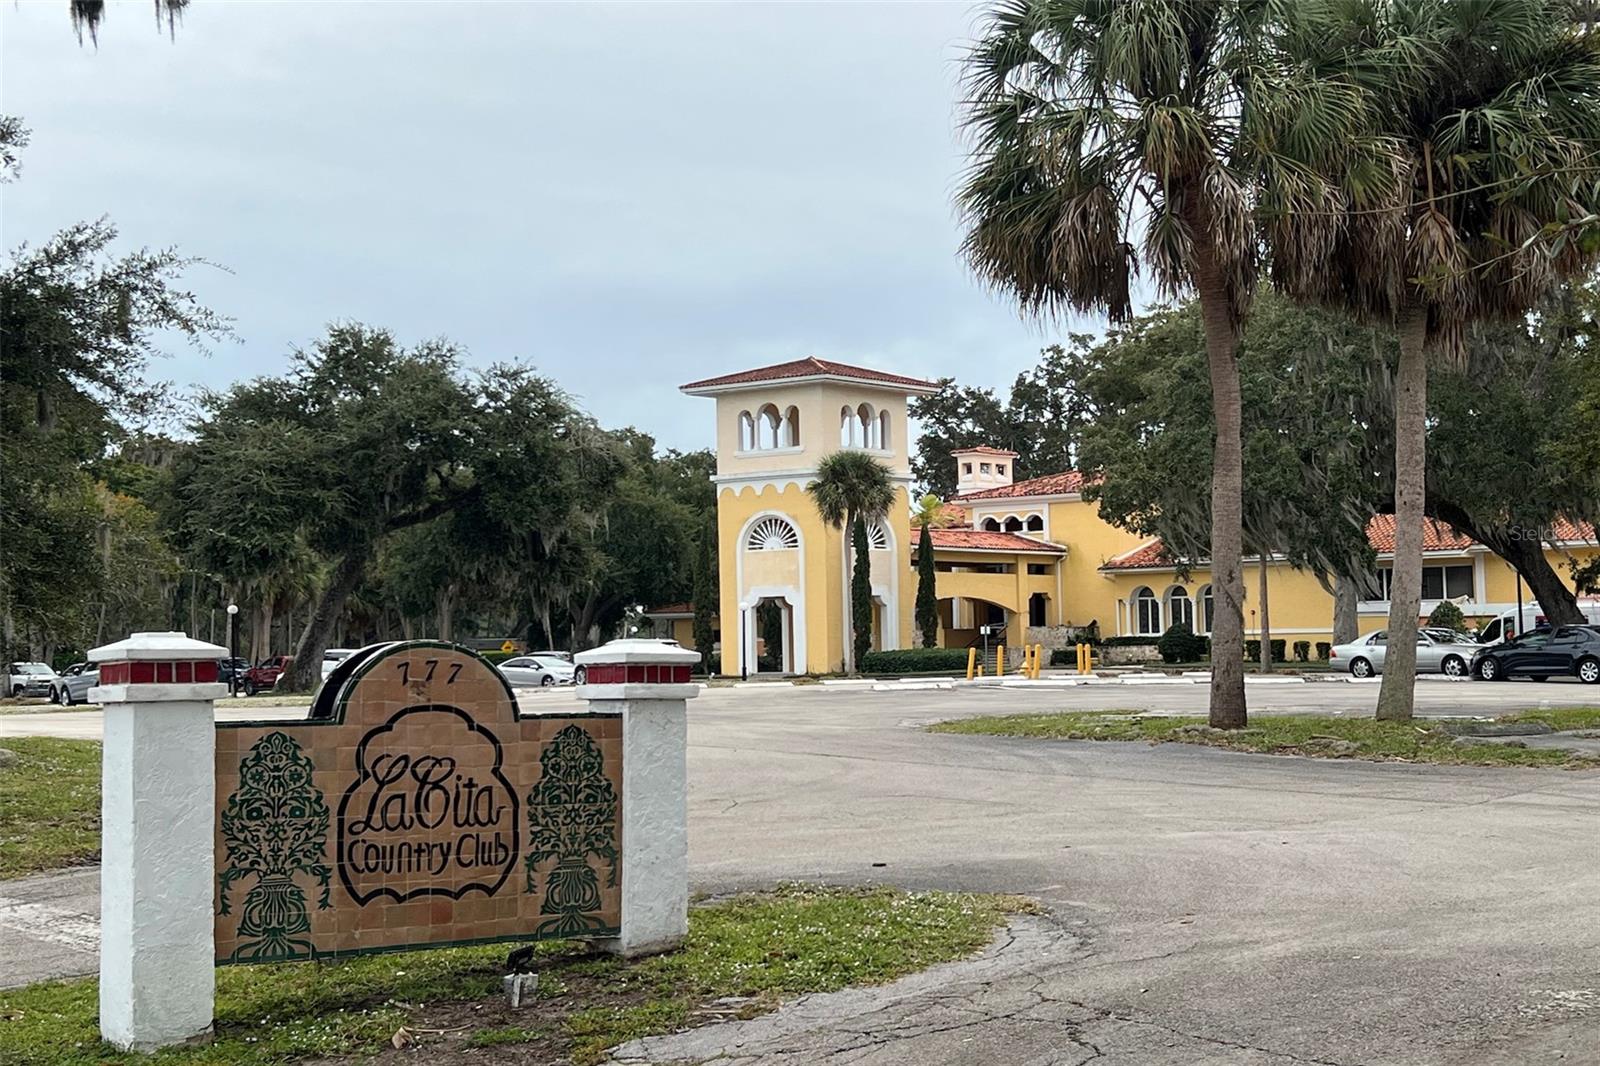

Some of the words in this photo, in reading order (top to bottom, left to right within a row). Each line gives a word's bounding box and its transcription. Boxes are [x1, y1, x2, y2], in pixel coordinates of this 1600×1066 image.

[398, 660, 463, 686] 777
[348, 754, 413, 833] La
[411, 756, 506, 830] Cita
[349, 838, 451, 876] Country
[457, 832, 508, 867] Club
